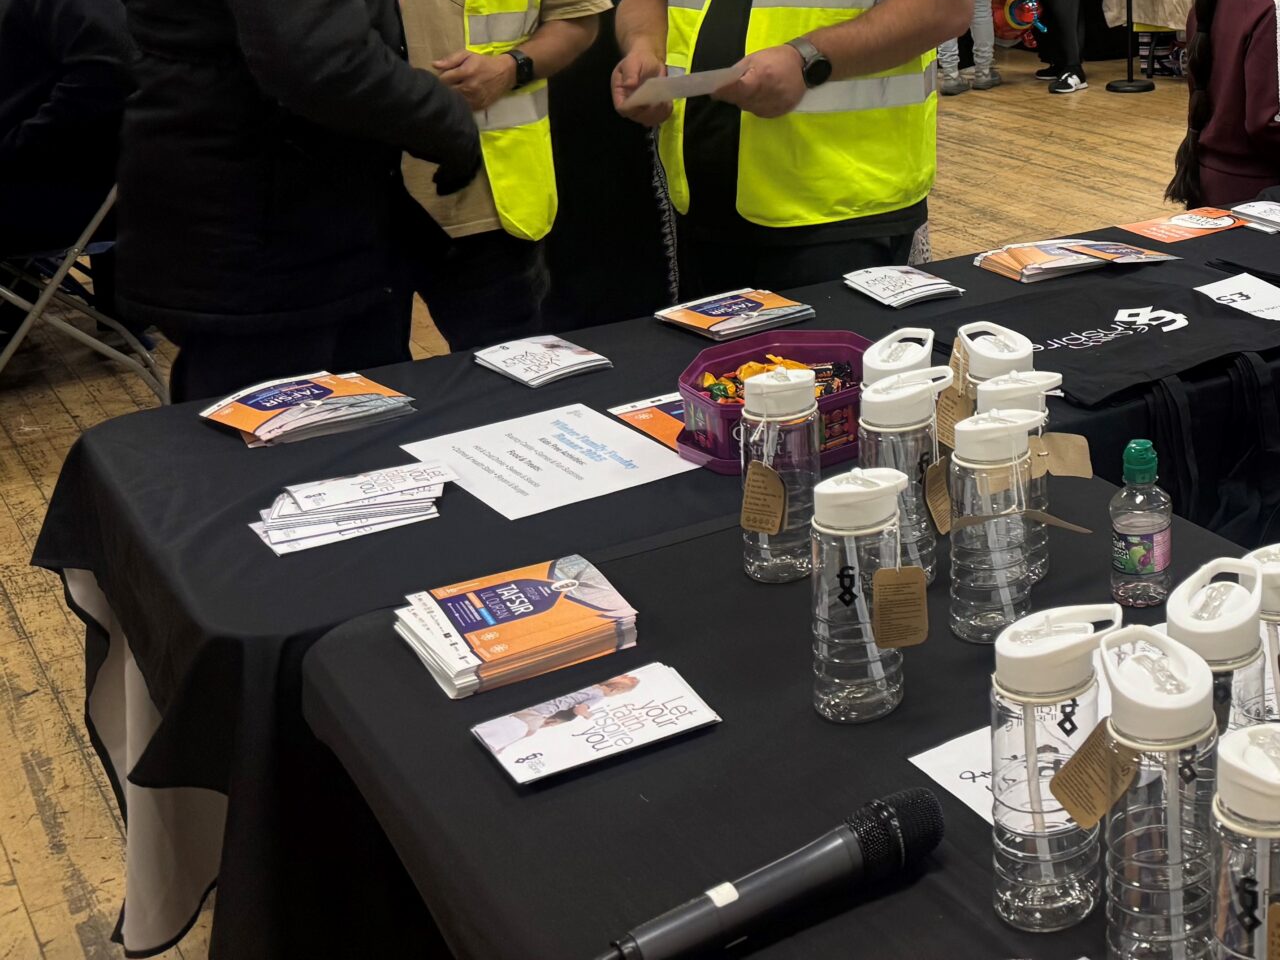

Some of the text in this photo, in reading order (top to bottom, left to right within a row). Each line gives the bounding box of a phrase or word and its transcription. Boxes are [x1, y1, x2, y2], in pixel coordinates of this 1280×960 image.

[1215, 291, 1252, 304] £5
[496, 584, 534, 616] TAFSIR
[610, 704, 650, 732] faith
[632, 699, 678, 728] your
[661, 695, 697, 721] Let
[572, 726, 614, 752] you
[590, 704, 634, 747] inspire
